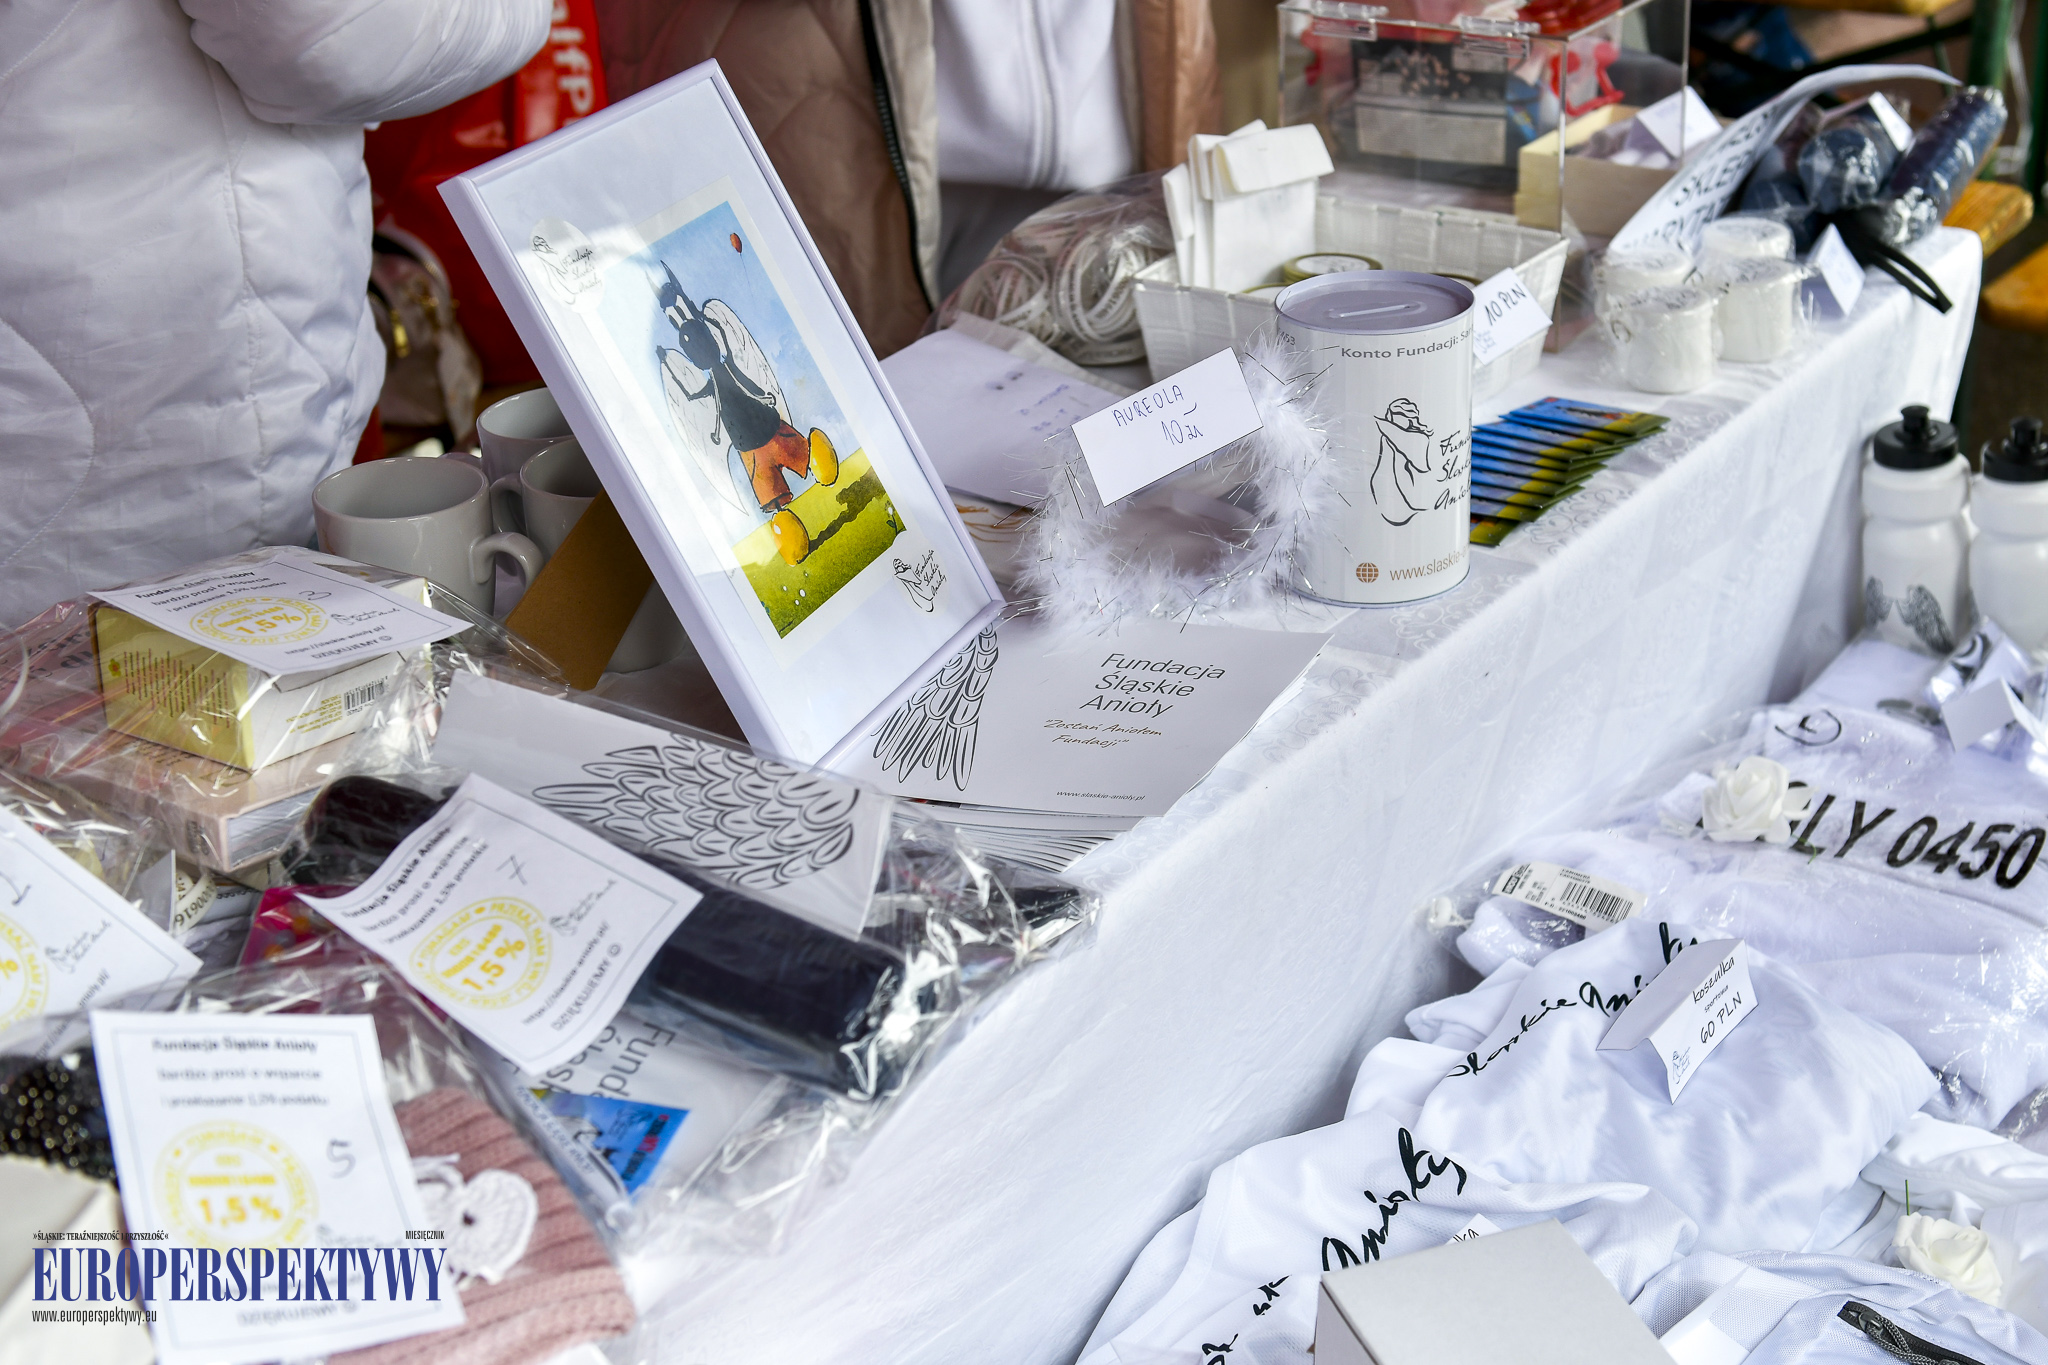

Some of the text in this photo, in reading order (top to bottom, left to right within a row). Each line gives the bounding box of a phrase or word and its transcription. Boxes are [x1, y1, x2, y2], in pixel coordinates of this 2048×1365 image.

[1485, 283, 1527, 326] 10 PLN
[1341, 347, 1392, 359] Konto
[1397, 336, 1459, 357] Fundacji:
[1112, 384, 1184, 427] AUREOLA
[1160, 419, 1184, 446] 10
[150, 593, 190, 607] bardzo
[190, 586, 217, 598] prosi
[235, 613, 302, 635] 1,5%
[1101, 653, 1226, 680] Fundacja
[1095, 671, 1195, 697] Śląskie
[1079, 695, 1174, 719] Anioły
[1102, 723, 1163, 736] Aniołem
[1886, 816, 2047, 889] 0450
[496, 854, 527, 886] 7
[462, 938, 526, 991] 1,5%
[1692, 957, 1735, 1004] koszulka
[1704, 985, 1729, 1013] sportowa
[1700, 991, 1742, 1044] 60 PLN
[326, 1139, 357, 1179] 5
[199, 1196, 282, 1228] 1,5%
